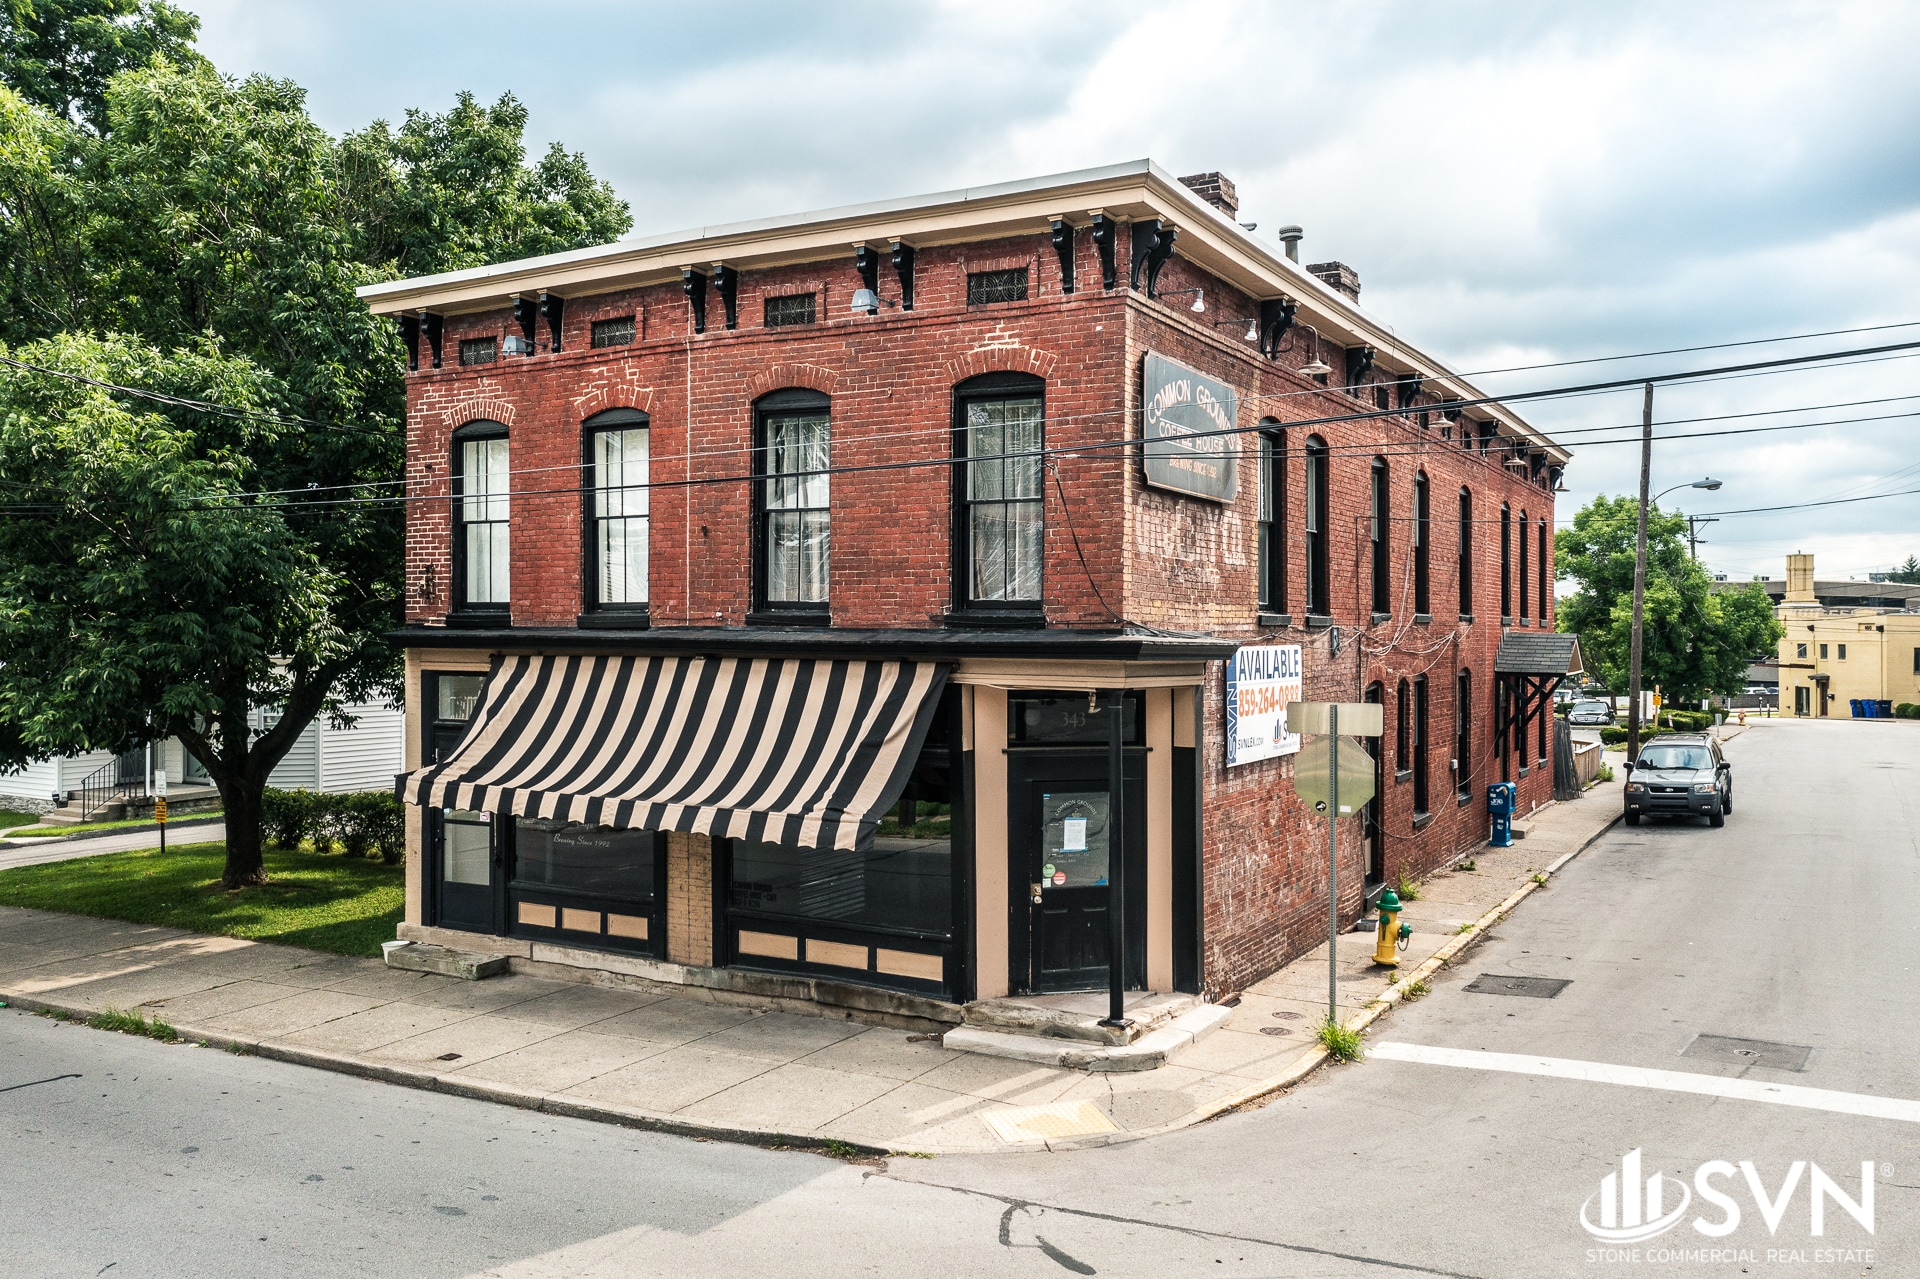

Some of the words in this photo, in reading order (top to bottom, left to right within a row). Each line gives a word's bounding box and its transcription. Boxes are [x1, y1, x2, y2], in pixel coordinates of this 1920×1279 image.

[1148, 379, 1191, 424] COMMON
[1196, 385, 1236, 450] GROUNDS
[1159, 421, 1193, 448] COFFEE
[1196, 435, 1225, 456] HOUSE
[1238, 649, 1299, 682] AVAILABLE
[1060, 711, 1086, 728] 343
[1054, 799, 1076, 816] COMMON
[1076, 799, 1097, 815] GROUNDS
[553, 833, 575, 846] Brewing
[576, 835, 593, 846] Since
[594, 840, 610, 848] 1992
